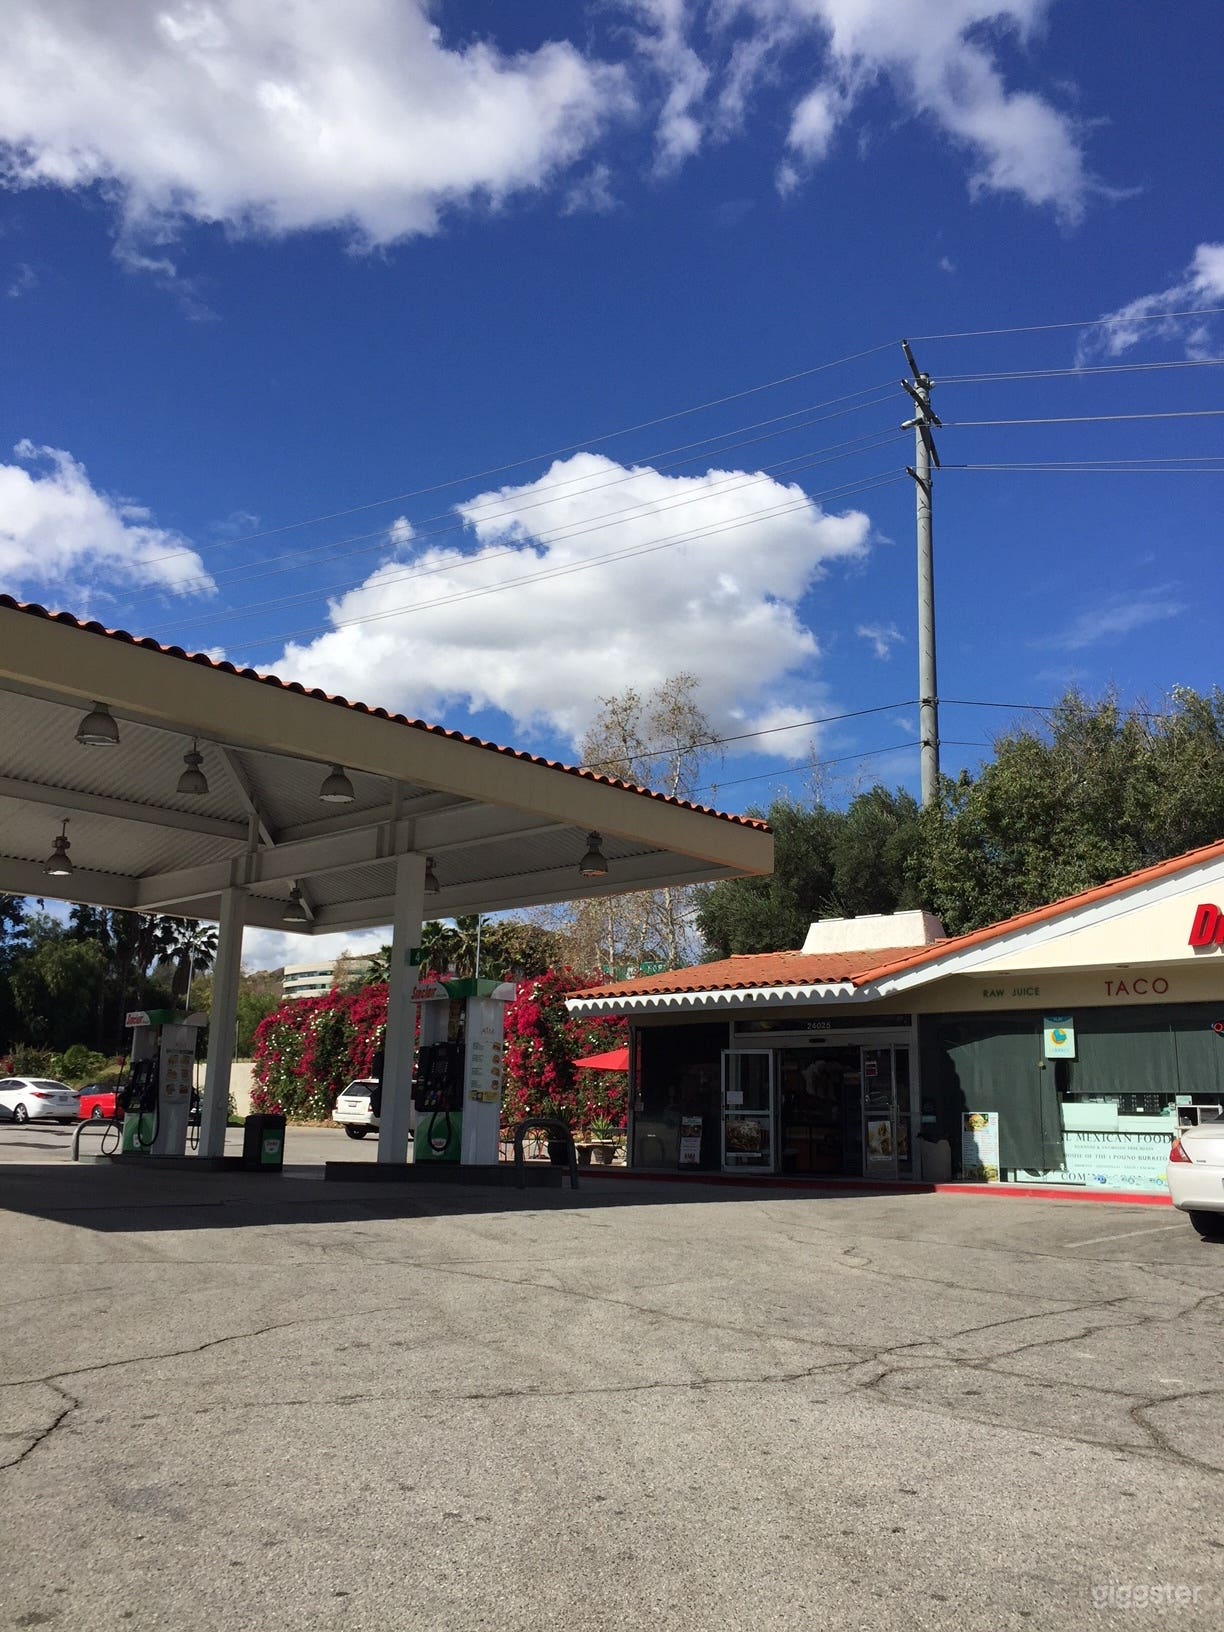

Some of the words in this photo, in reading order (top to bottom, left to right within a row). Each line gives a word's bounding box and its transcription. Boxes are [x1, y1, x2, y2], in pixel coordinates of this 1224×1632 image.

[983, 989, 1005, 998] RAW
[1012, 986, 1040, 997] JUICE
[1104, 977, 1169, 997] TACO
[1076, 1132, 1132, 1143] MEXICAN
[1137, 1134, 1171, 1144] FOOD
